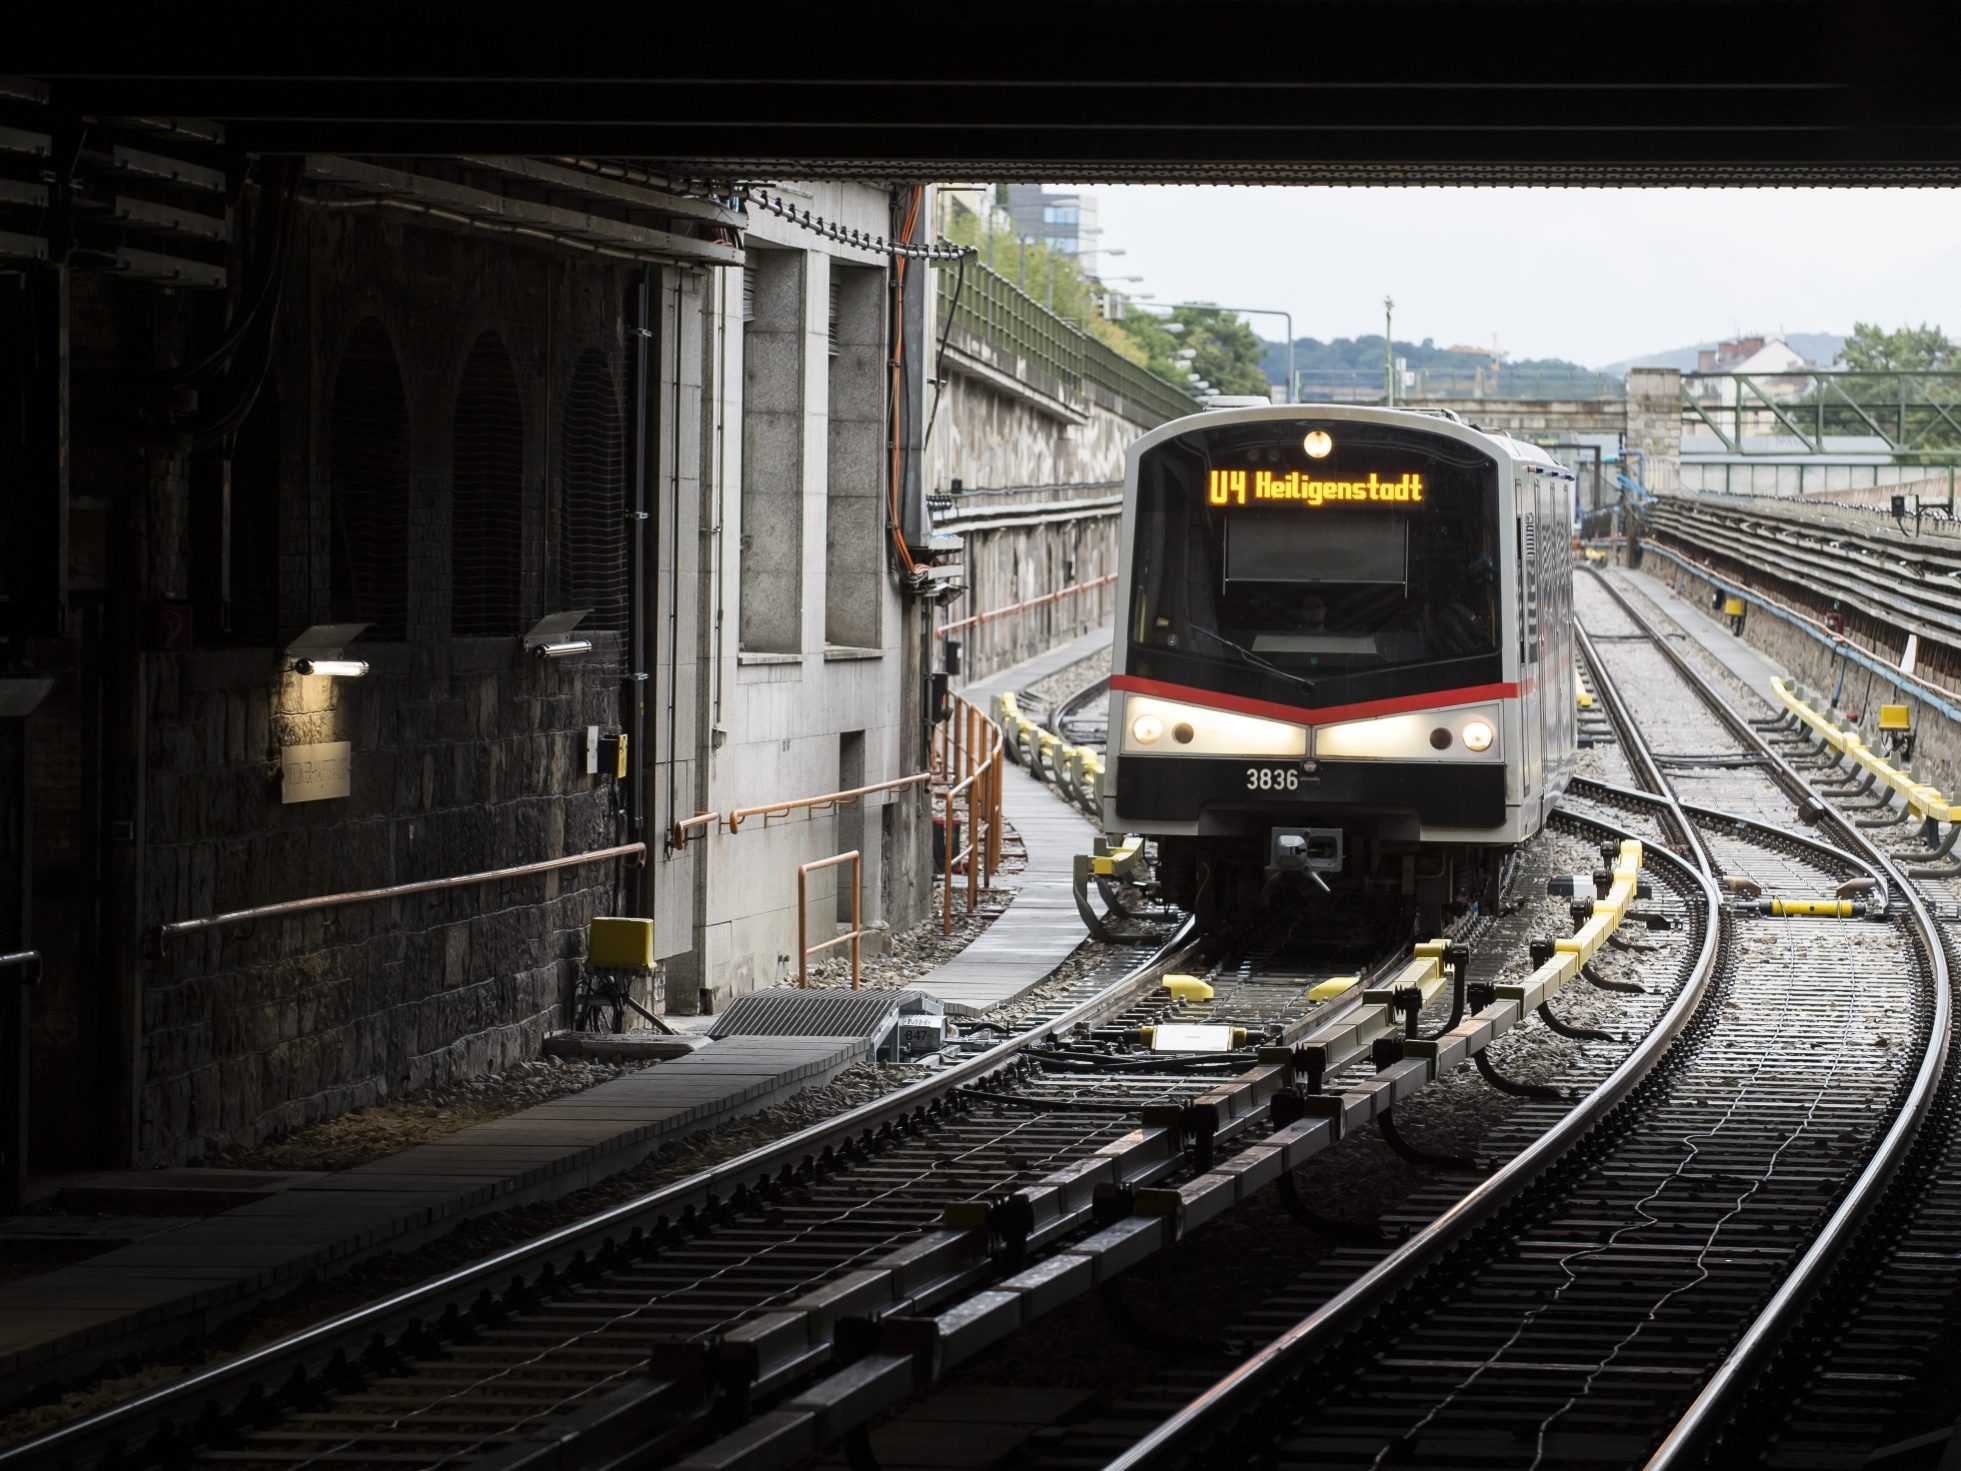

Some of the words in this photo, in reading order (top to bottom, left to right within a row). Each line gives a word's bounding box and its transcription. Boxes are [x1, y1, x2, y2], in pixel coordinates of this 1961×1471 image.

[1210, 470, 1246, 504] U4
[1255, 470, 1422, 505] Heiligenstadt
[1247, 768, 1298, 789] 3836
